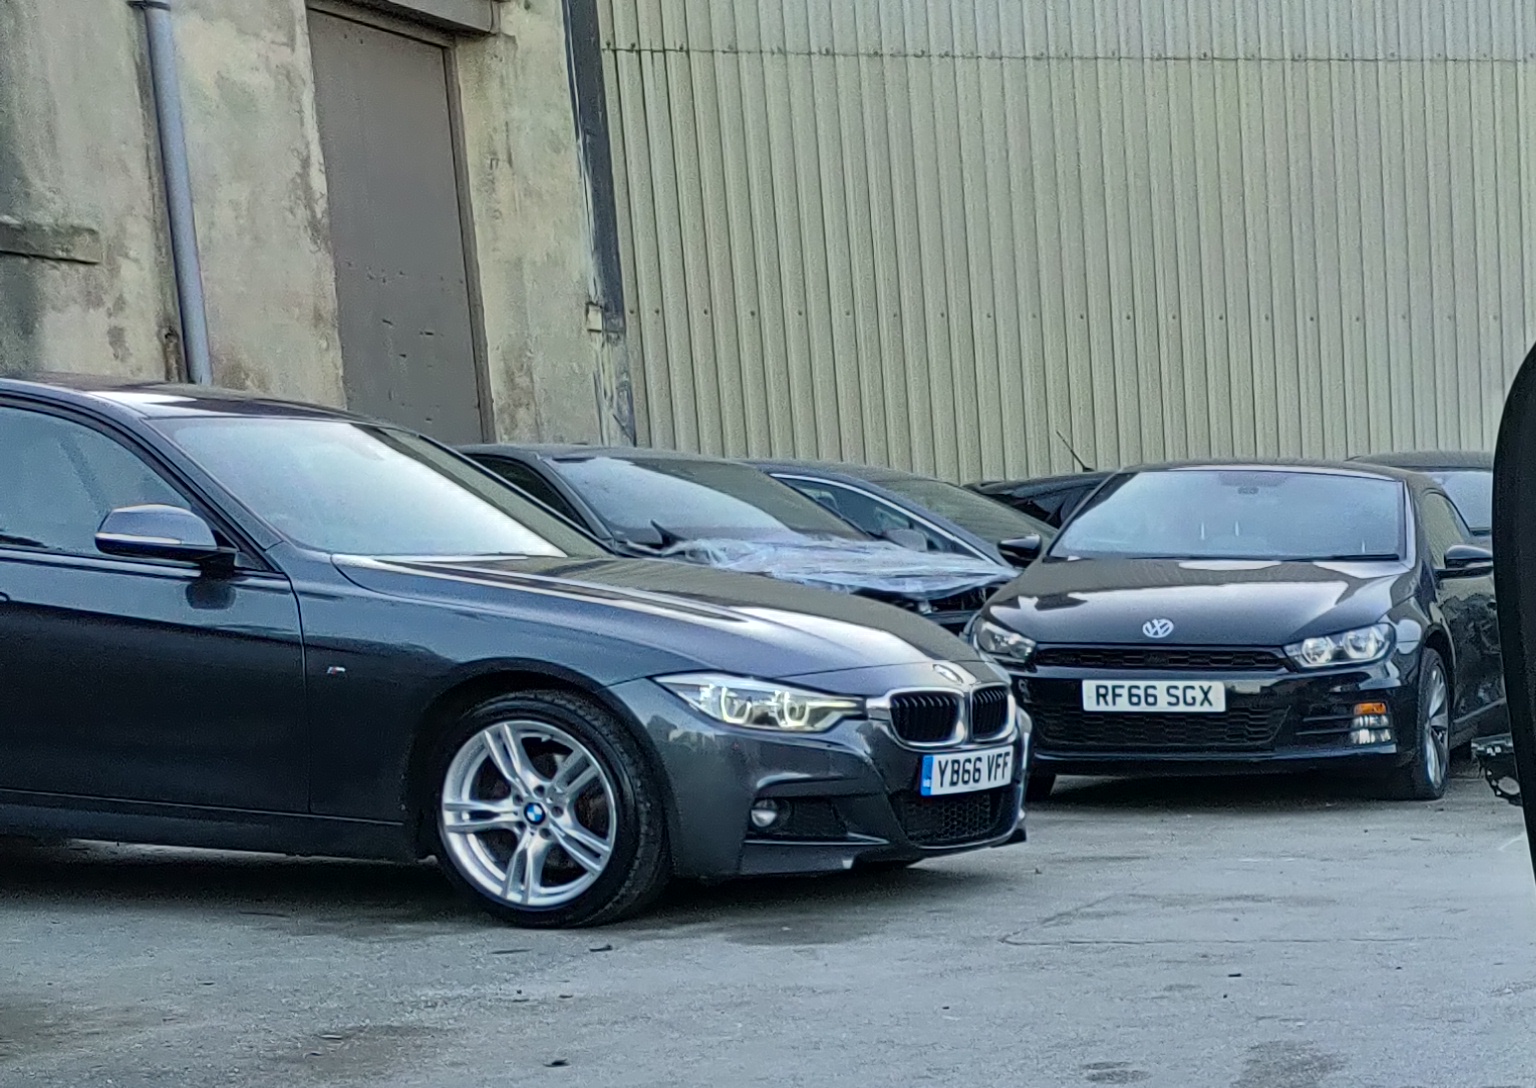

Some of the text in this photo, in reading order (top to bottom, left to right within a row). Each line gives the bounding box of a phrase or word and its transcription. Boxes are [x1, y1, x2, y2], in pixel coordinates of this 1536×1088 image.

[1095, 684, 1213, 707] RF66 SGX
[938, 751, 1011, 789] YB66 VFF
